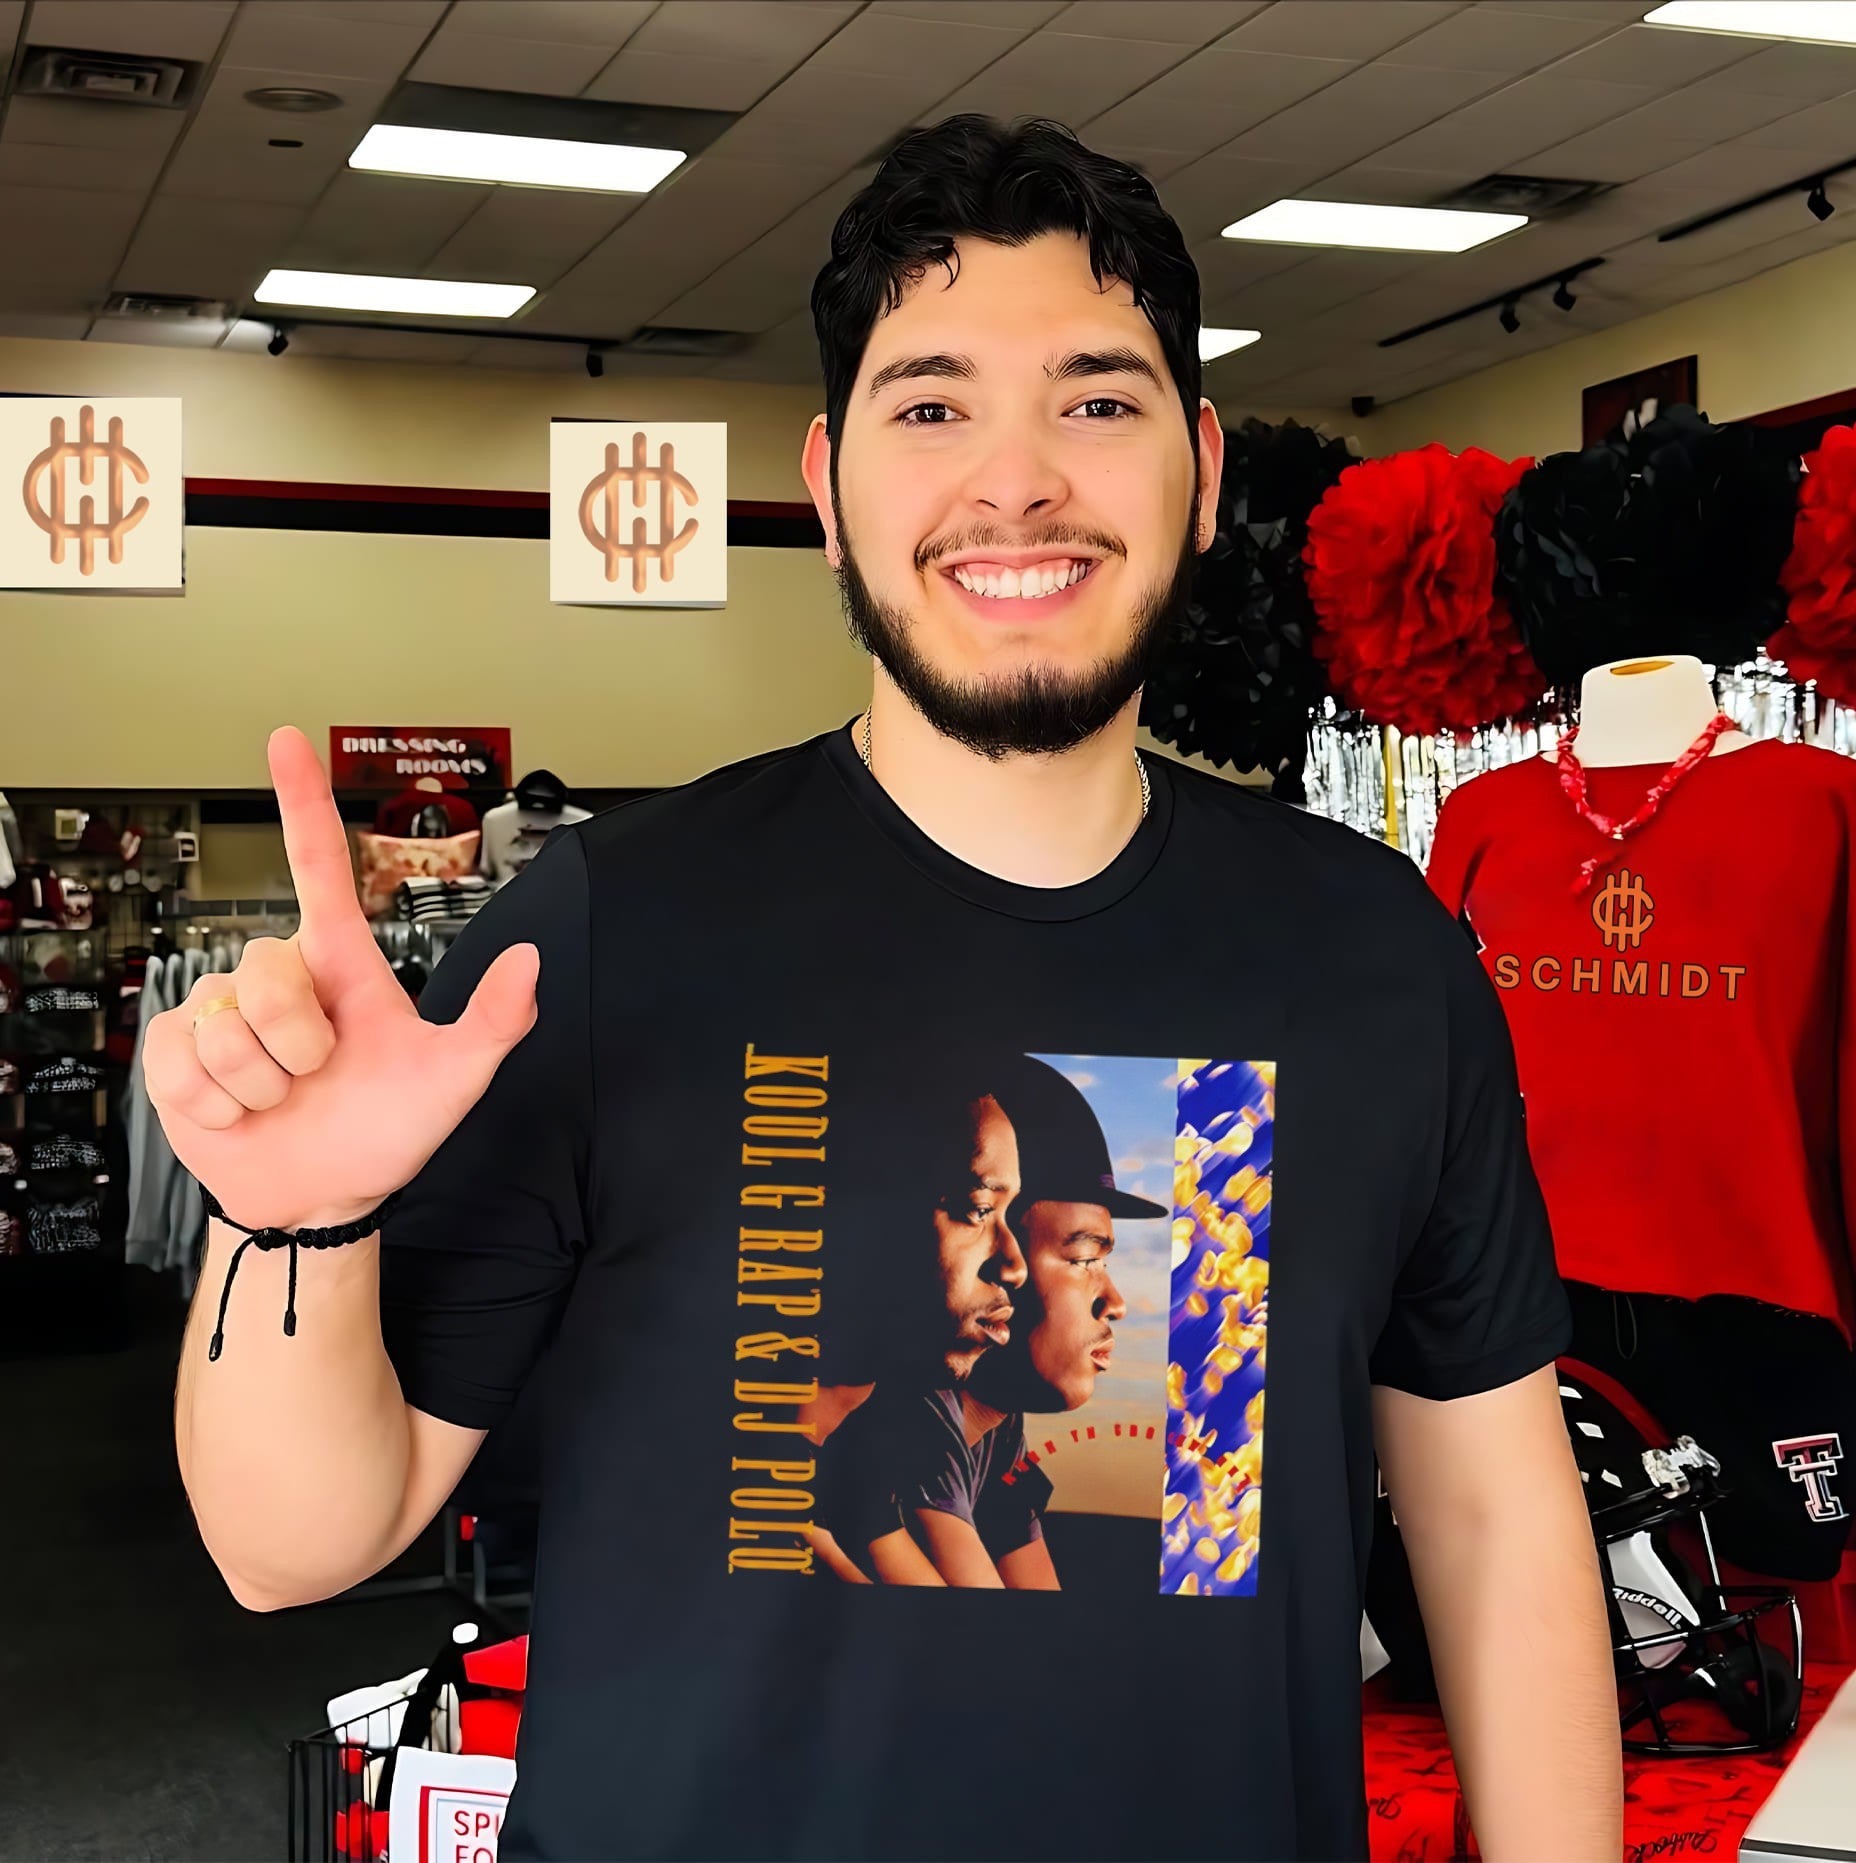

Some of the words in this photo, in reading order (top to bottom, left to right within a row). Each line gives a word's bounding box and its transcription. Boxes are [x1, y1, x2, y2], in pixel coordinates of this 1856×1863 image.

[395, 757, 488, 775] ROOMS
[1494, 953, 1747, 1000] SCHMIDT
[742, 1046, 830, 1166] KOOL
[740, 1183, 826, 1210] G
[737, 1226, 824, 1317] RAP
[735, 1330, 821, 1361] &
[733, 1378, 820, 1436] DJ
[728, 1457, 817, 1575] POLO
